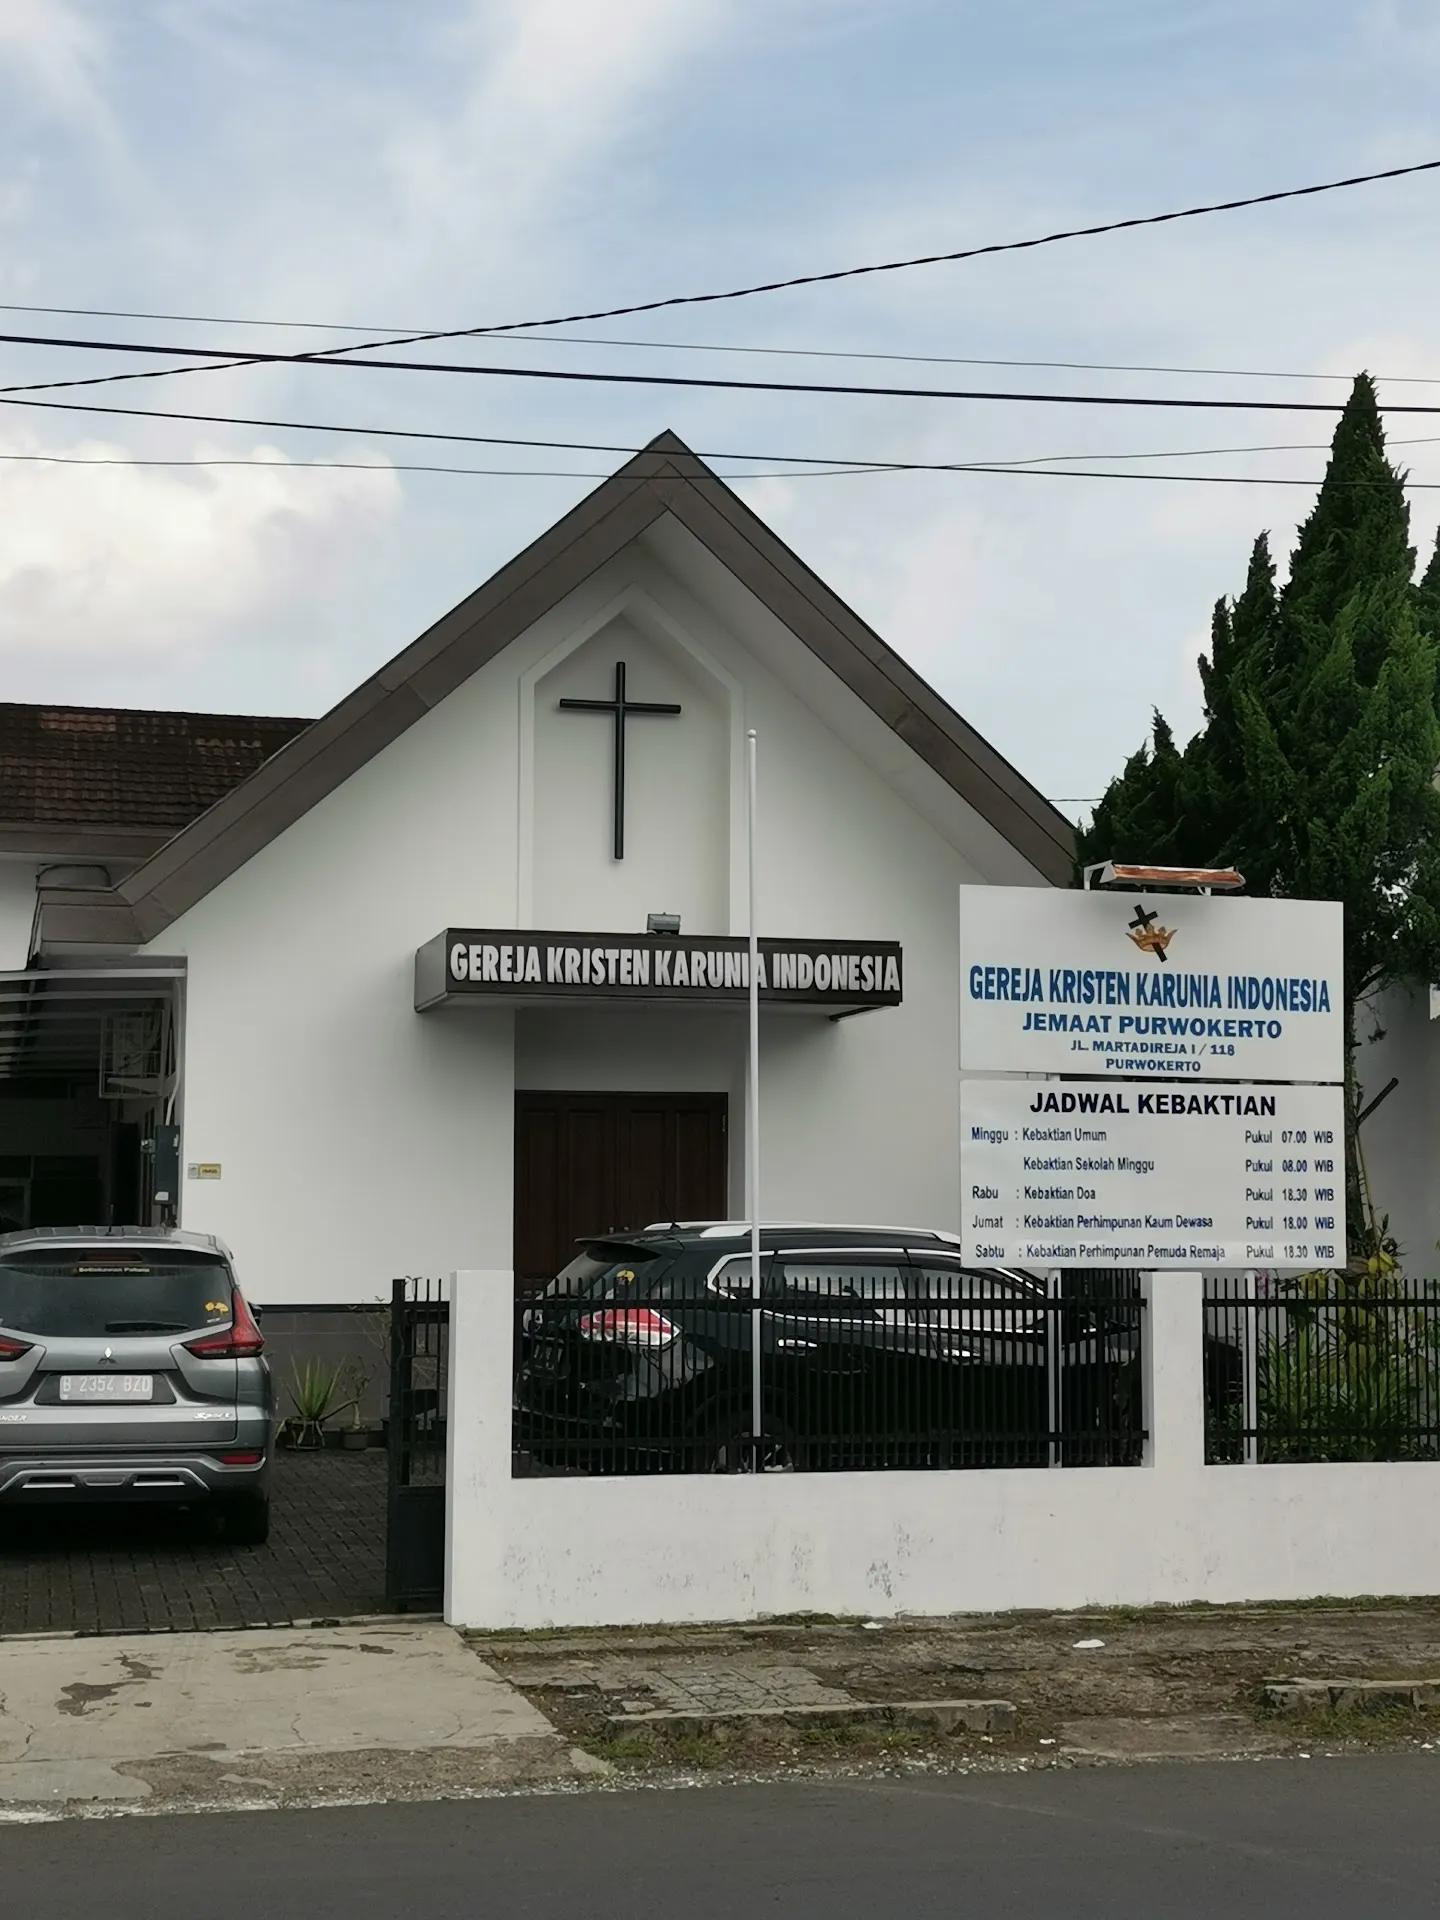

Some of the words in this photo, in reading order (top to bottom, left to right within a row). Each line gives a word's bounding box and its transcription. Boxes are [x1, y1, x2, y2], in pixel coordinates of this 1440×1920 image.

[451, 943, 541, 982] GEREJA
[547, 947, 649, 984] KRISTEN
[655, 949, 768, 989] KARUNIA
[773, 953, 900, 991] INDONESIA
[970, 966, 1043, 1002] GEREJA
[1050, 969, 1130, 1005] KRISTEN
[1137, 973, 1222, 1008] KARUNIA
[1228, 976, 1330, 1012] INDONESIA
[1022, 1012, 1113, 1034] JEMAAT
[1118, 1015, 1283, 1040] PURWOKERTO
[1070, 1039, 1090, 1052] JL.
[1092, 1040, 1188, 1055] MARTADIREJA
[1210, 1043, 1236, 1057] 118
[1105, 1057, 1202, 1073] PURWOKERTO
[1029, 1092, 1130, 1114] JADWAL
[1137, 1093, 1276, 1117] KEBAKTIAN
[971, 1126, 1009, 1144] Minggu
[1022, 1127, 1072, 1142] Kebaktian
[1074, 1127, 1107, 1142] Umum
[1244, 1129, 1273, 1144] Pukul
[1281, 1130, 1307, 1144] 07.00
[1313, 1130, 1334, 1144] WIB
[1023, 1156, 1074, 1171] Kebaktian
[1075, 1156, 1115, 1171] Sekolah
[1117, 1156, 1155, 1175] Minggu
[1245, 1158, 1273, 1173] Pukul
[1281, 1159, 1308, 1173] 08.00
[1314, 1159, 1334, 1173] WIB
[972, 1185, 999, 1200] Rabu
[1024, 1185, 1074, 1200] Kebaktian
[1076, 1185, 1096, 1200] Doa
[1245, 1187, 1274, 1202] Pukul
[1282, 1187, 1308, 1202] 18.30
[1314, 1188, 1335, 1202] WIB
[971, 1214, 1004, 1229] Jumat
[1023, 1214, 1075, 1229] Kebaktian
[1076, 1214, 1143, 1232] Perhimpunan
[1144, 1214, 1174, 1229] Kaum
[1175, 1214, 1214, 1229] Dewasa
[1245, 1216, 1274, 1230] Pukul
[1282, 1216, 1308, 1230] 18.00
[1314, 1216, 1335, 1230] WIB
[975, 1243, 1005, 1259] Sabtu
[1026, 1244, 1077, 1258] Kebaktian
[1079, 1243, 1145, 1262] Perhimpunan
[1146, 1244, 1187, 1258] Pemuda
[1189, 1244, 1226, 1262] Remaja
[1245, 1244, 1275, 1259] Pukul
[1283, 1244, 1309, 1259] 18.30
[1314, 1245, 1335, 1259] WIB
